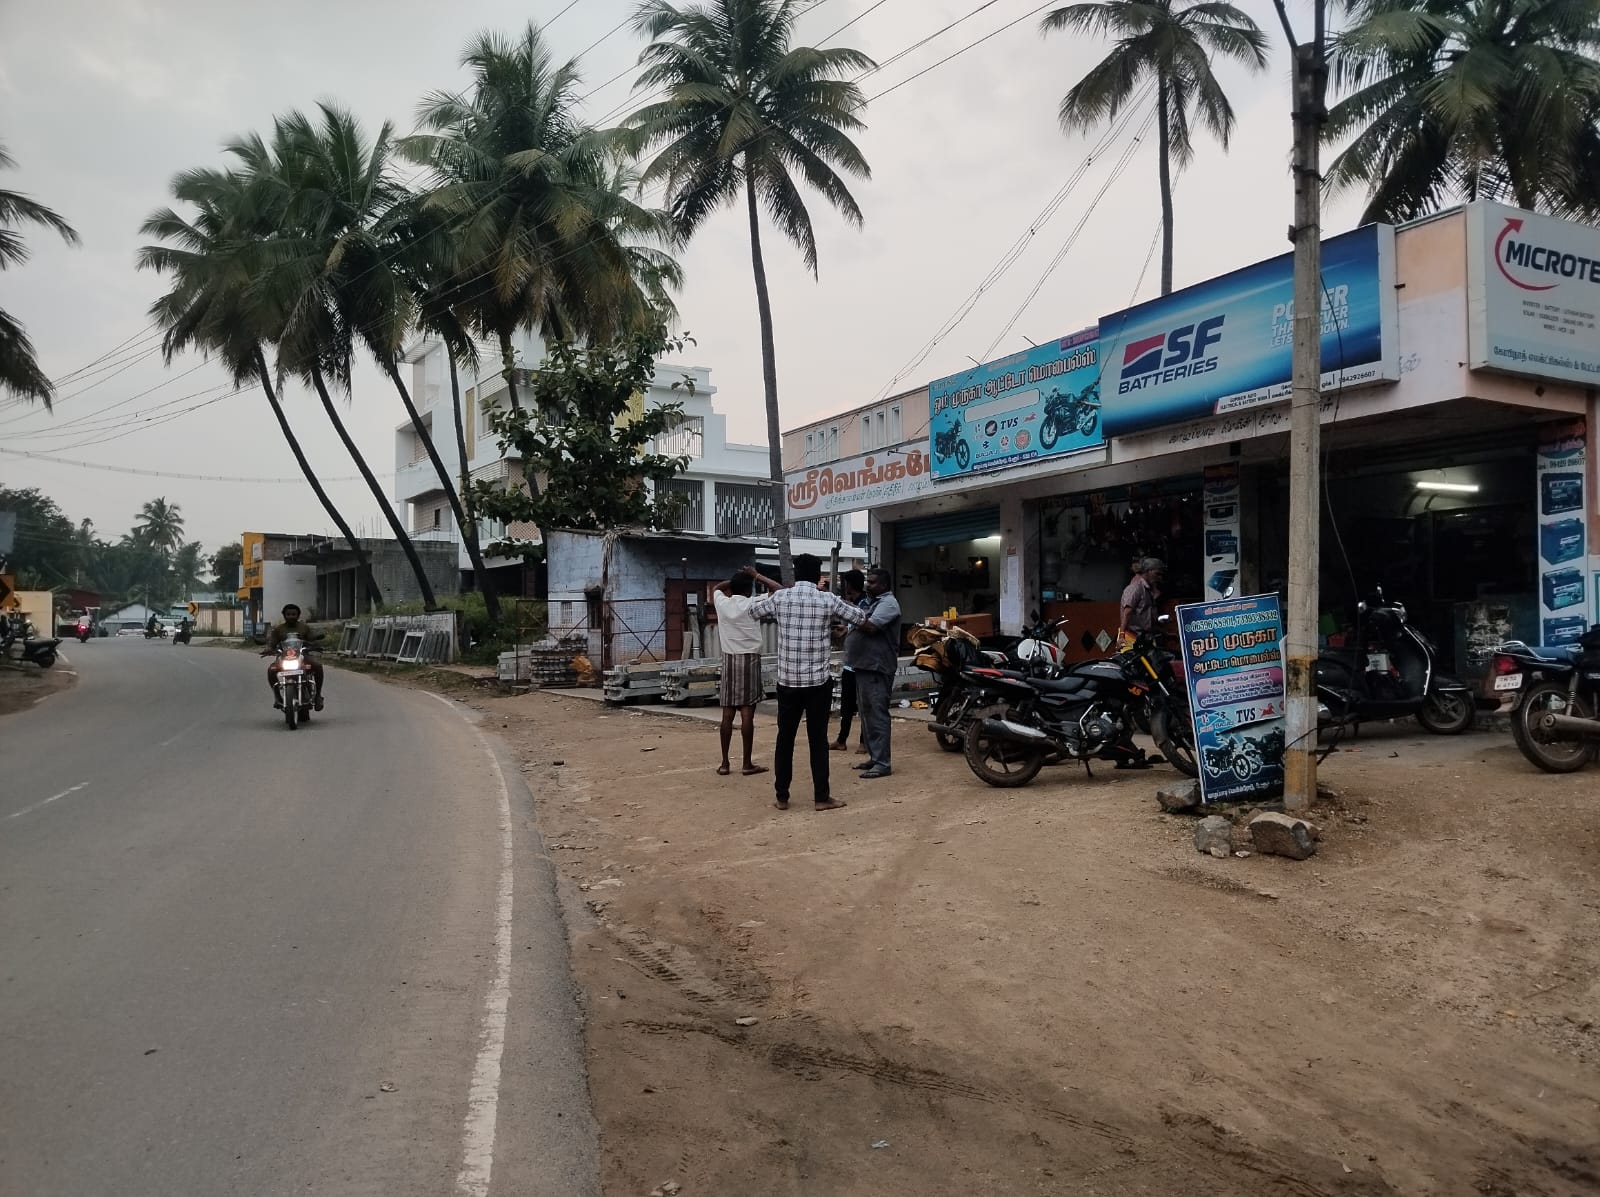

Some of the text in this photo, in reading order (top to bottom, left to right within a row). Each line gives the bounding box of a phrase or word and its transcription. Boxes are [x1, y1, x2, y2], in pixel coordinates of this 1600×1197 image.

[1505, 240, 1600, 284] MICROTE
[1163, 313, 1226, 368] SF
[952, 383, 982, 409] முருகா
[984, 370, 1026, 397] ஆட்டோ
[1118, 356, 1218, 395] BATTERIES
[1000, 417, 1019, 430] TVS
[1191, 628, 1277, 657] ஓம் முருகா
[1236, 708, 1256, 722] TVS
